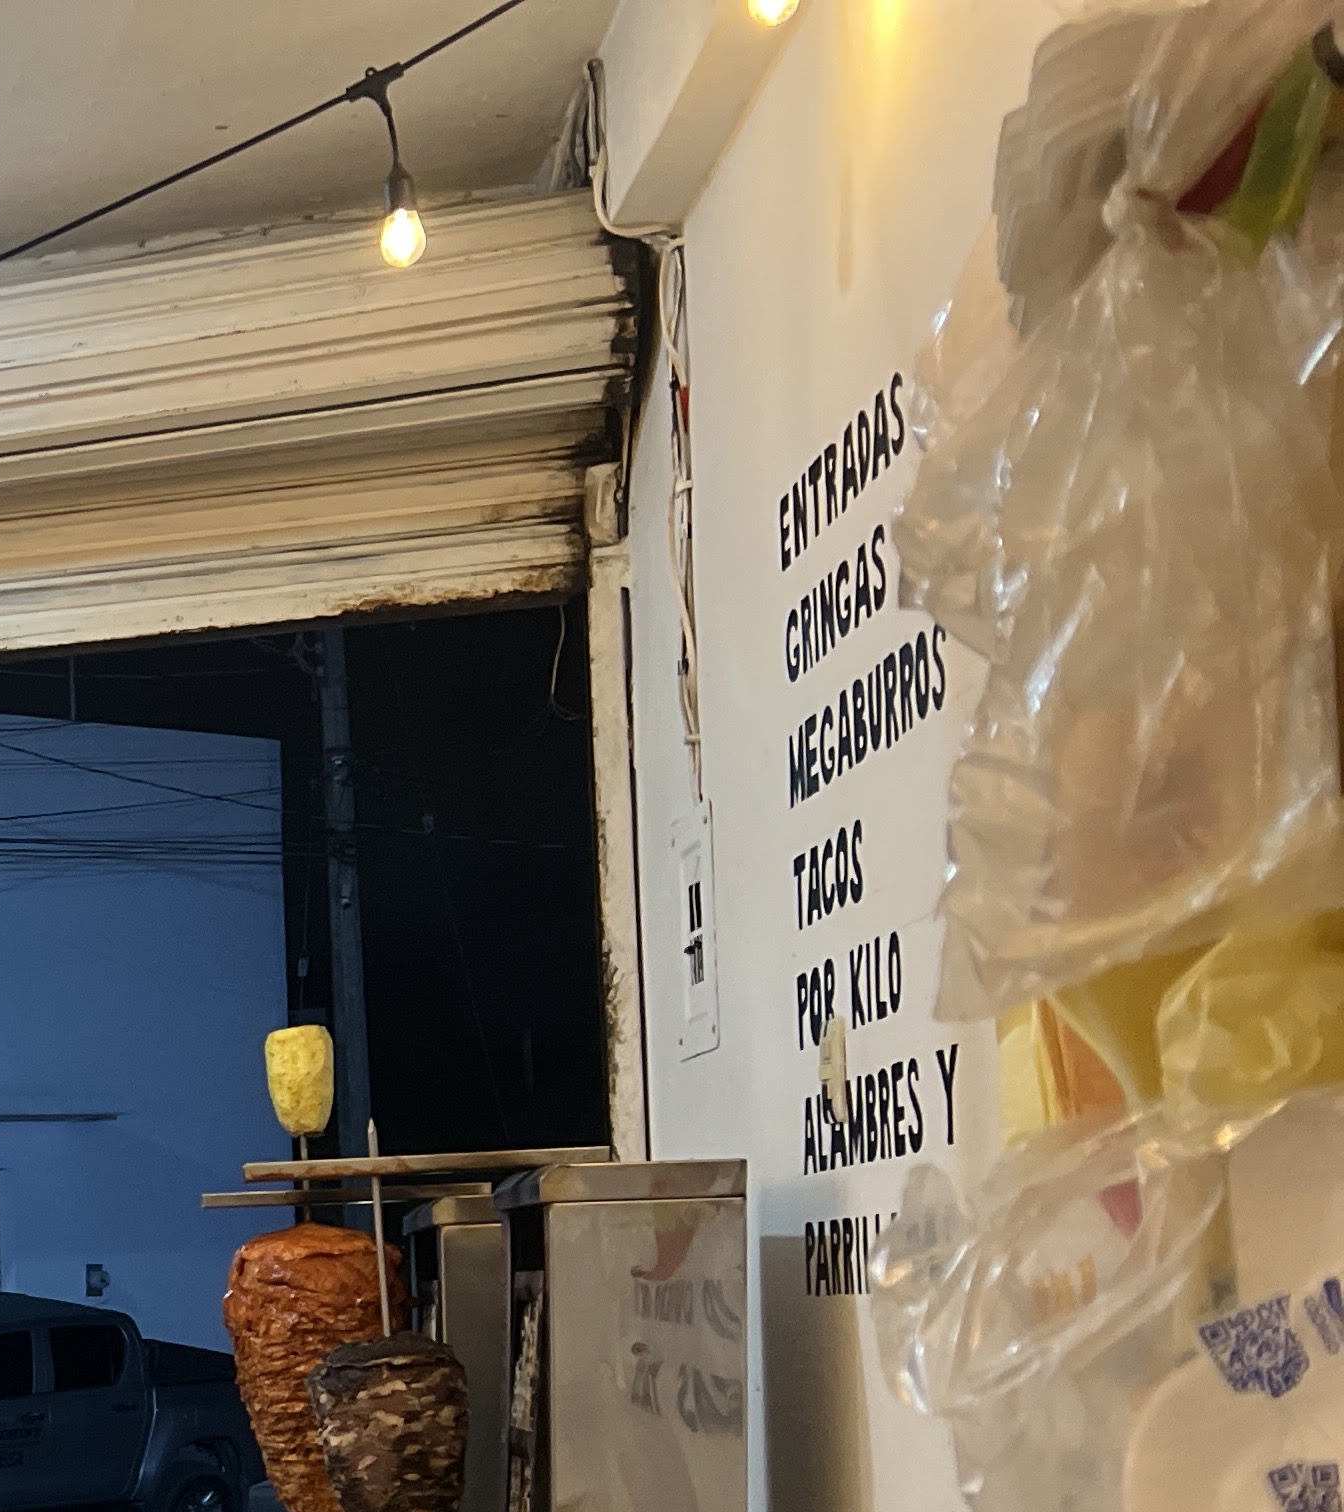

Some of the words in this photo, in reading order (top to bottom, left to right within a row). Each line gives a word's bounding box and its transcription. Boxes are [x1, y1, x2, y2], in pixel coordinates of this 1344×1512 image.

[780, 371, 905, 572] ENTRADAS
[786, 523, 887, 683] GRINGAS
[789, 623, 946, 810] MEGABURROS
[793, 819, 863, 931] TACOS
[796, 958, 836, 1051] POR
[849, 931, 902, 1030] KILO
[935, 1043, 959, 1145] Y
